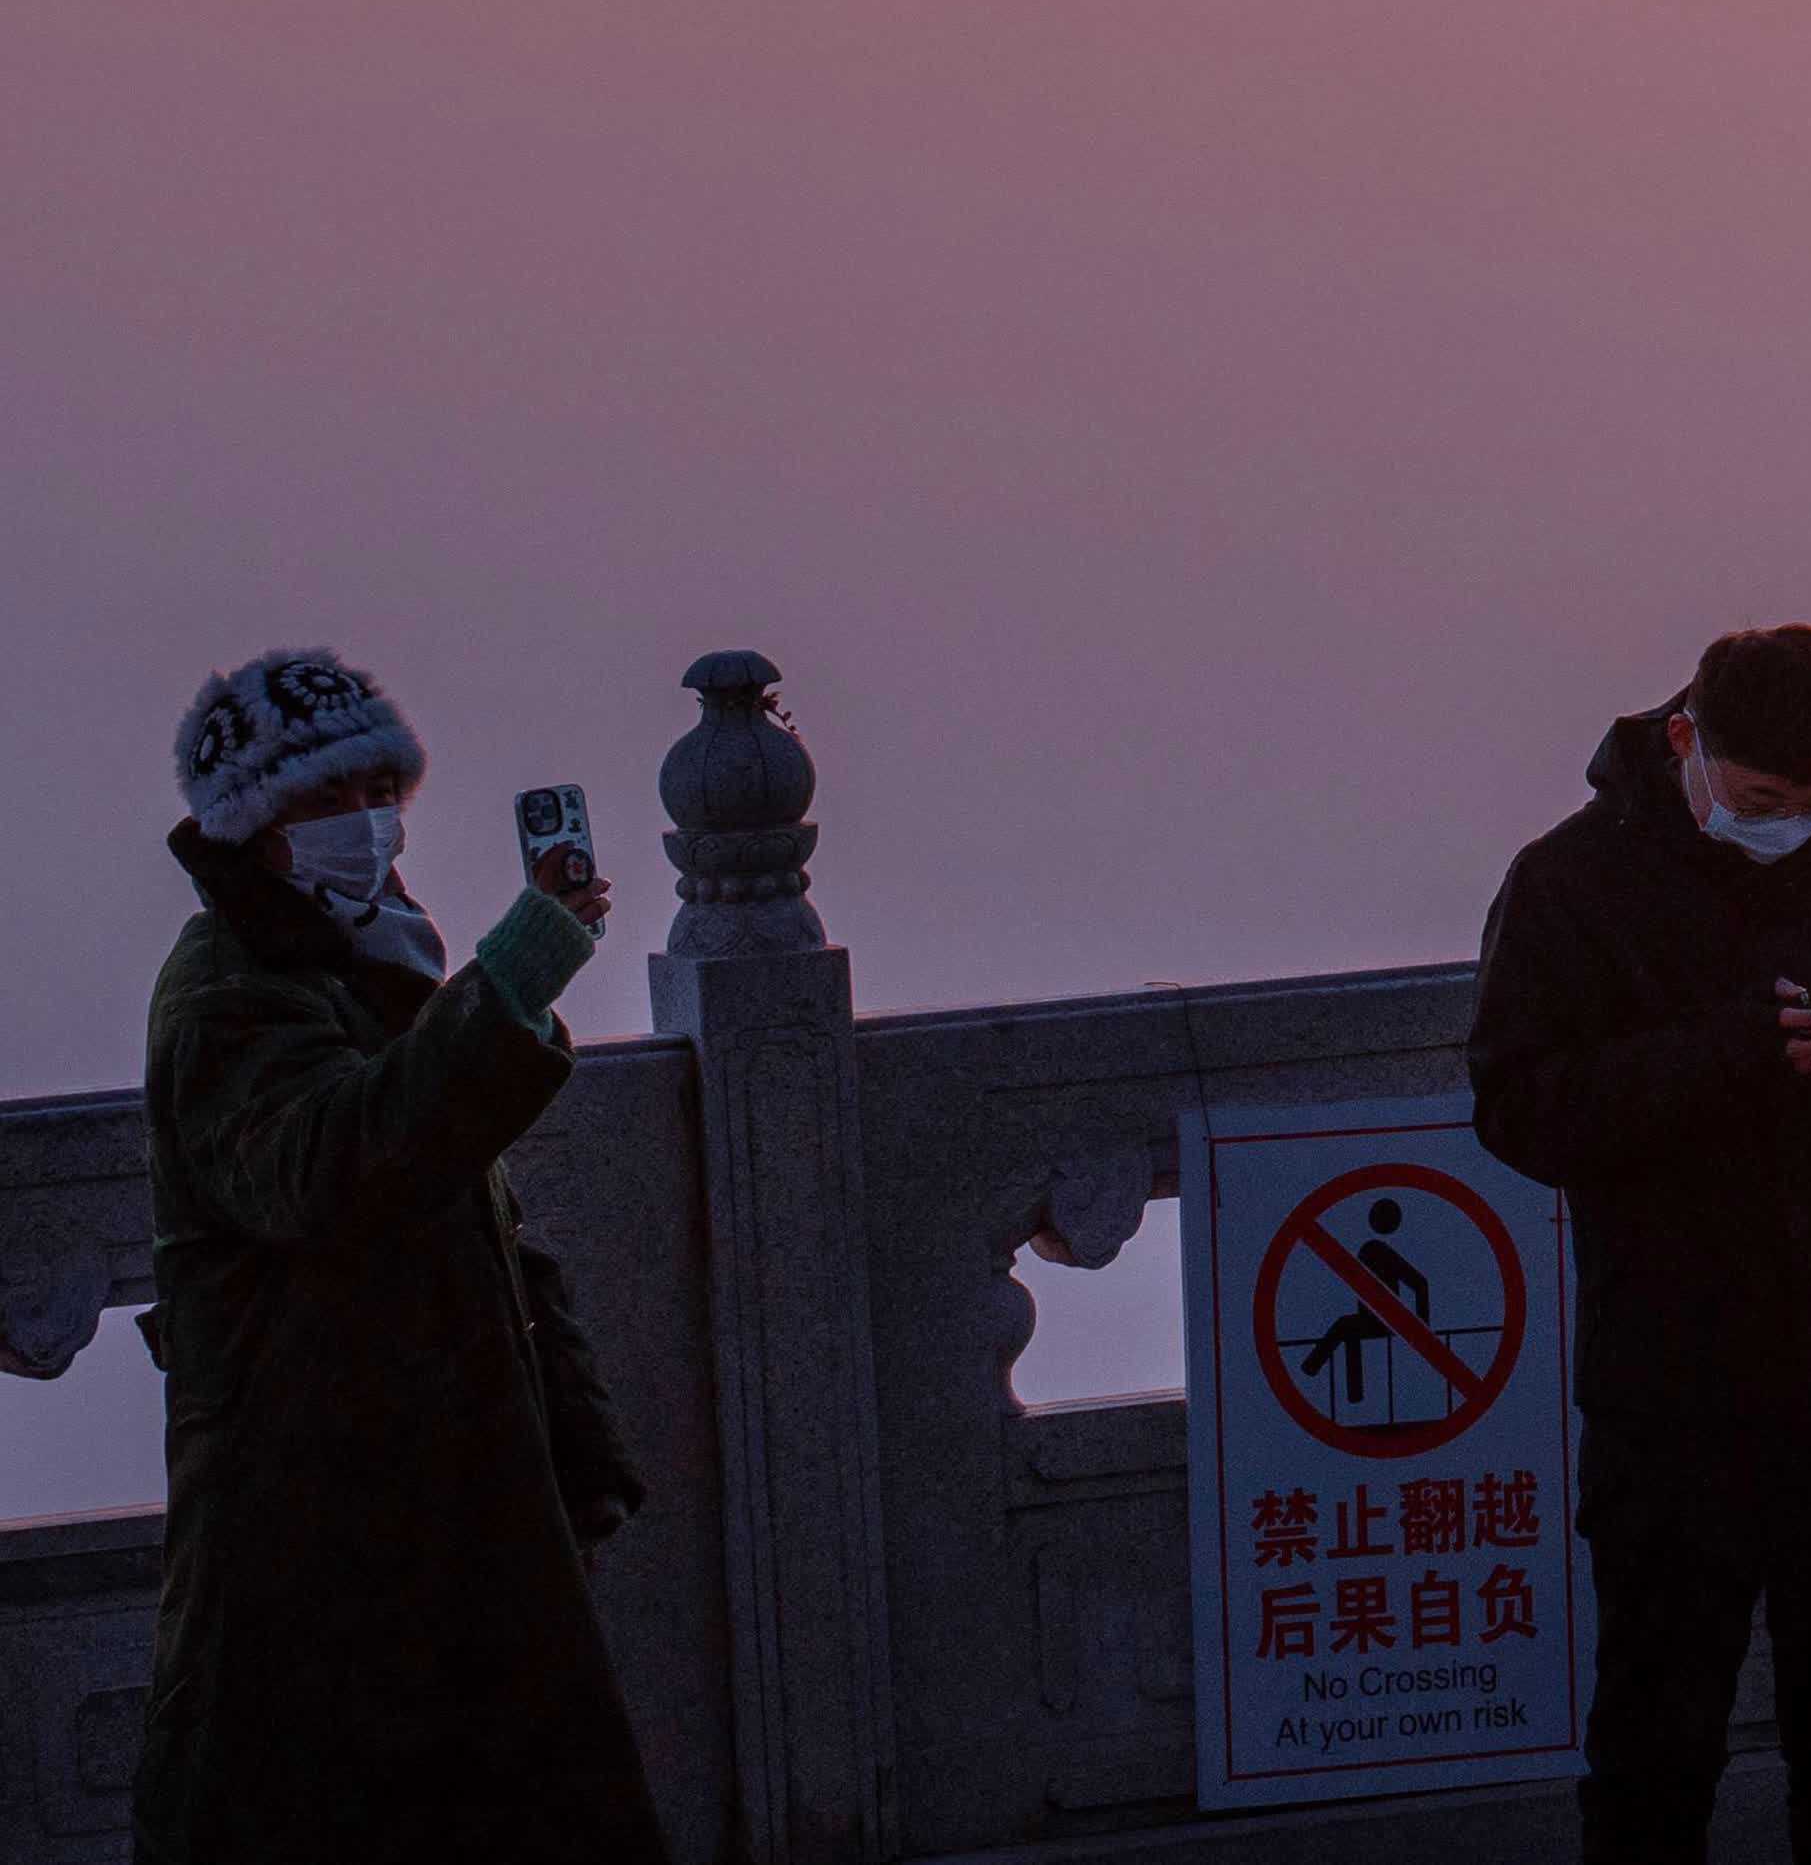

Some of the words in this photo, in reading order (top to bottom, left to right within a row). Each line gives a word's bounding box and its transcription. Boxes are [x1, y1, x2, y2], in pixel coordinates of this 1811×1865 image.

[1252, 1470, 1540, 1566] 禁止翻越
[1256, 1564, 1537, 1659] 后果自负
[1304, 1671, 1347, 1702] No
[1359, 1660, 1497, 1695] Crossing
[1276, 1717, 1309, 1747] At
[1320, 1715, 1389, 1751] your
[1399, 1709, 1462, 1736] own
[1474, 1698, 1528, 1729] risk
